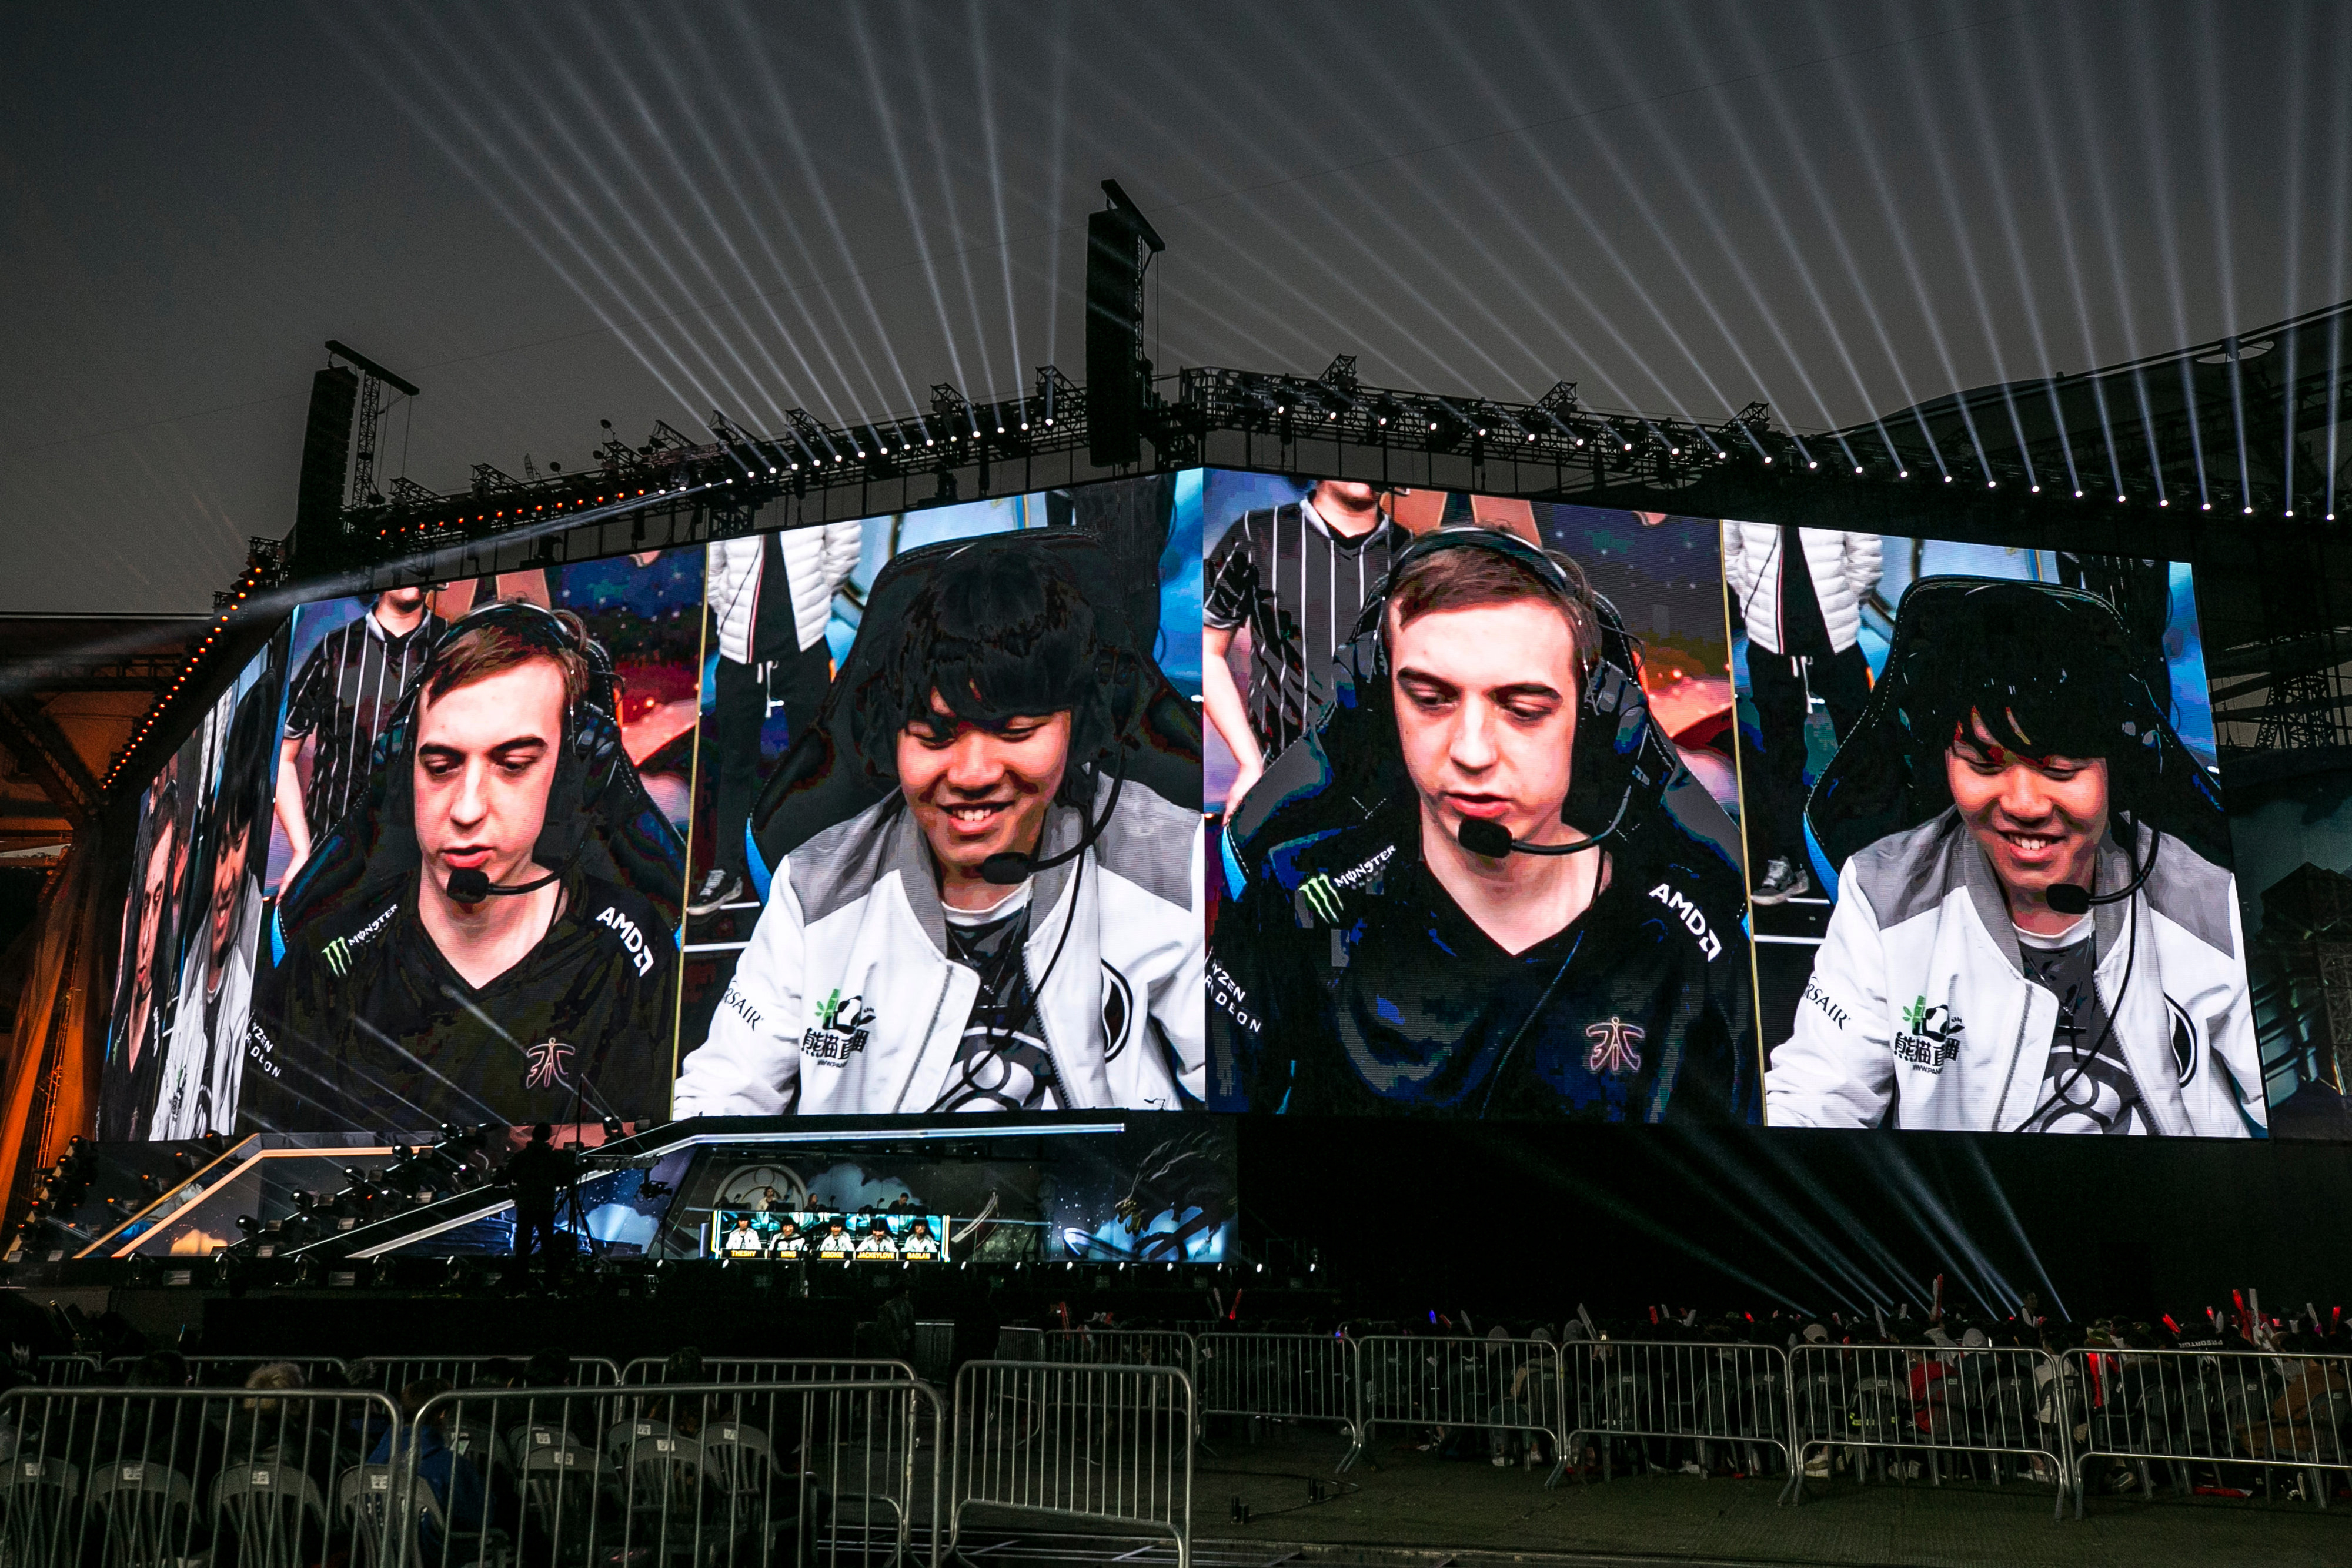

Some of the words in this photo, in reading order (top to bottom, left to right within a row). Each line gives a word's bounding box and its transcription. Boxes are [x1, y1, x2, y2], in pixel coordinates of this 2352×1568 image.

[1334, 845, 1396, 887] MONSTER
[348, 904, 398, 946] MONSTER
[595, 906, 643, 953] AMD
[1648, 883, 1706, 935] AMD
[1205, 975, 1261, 1032] RDEON
[2178, 1340, 2223, 1348] PREDATOR
